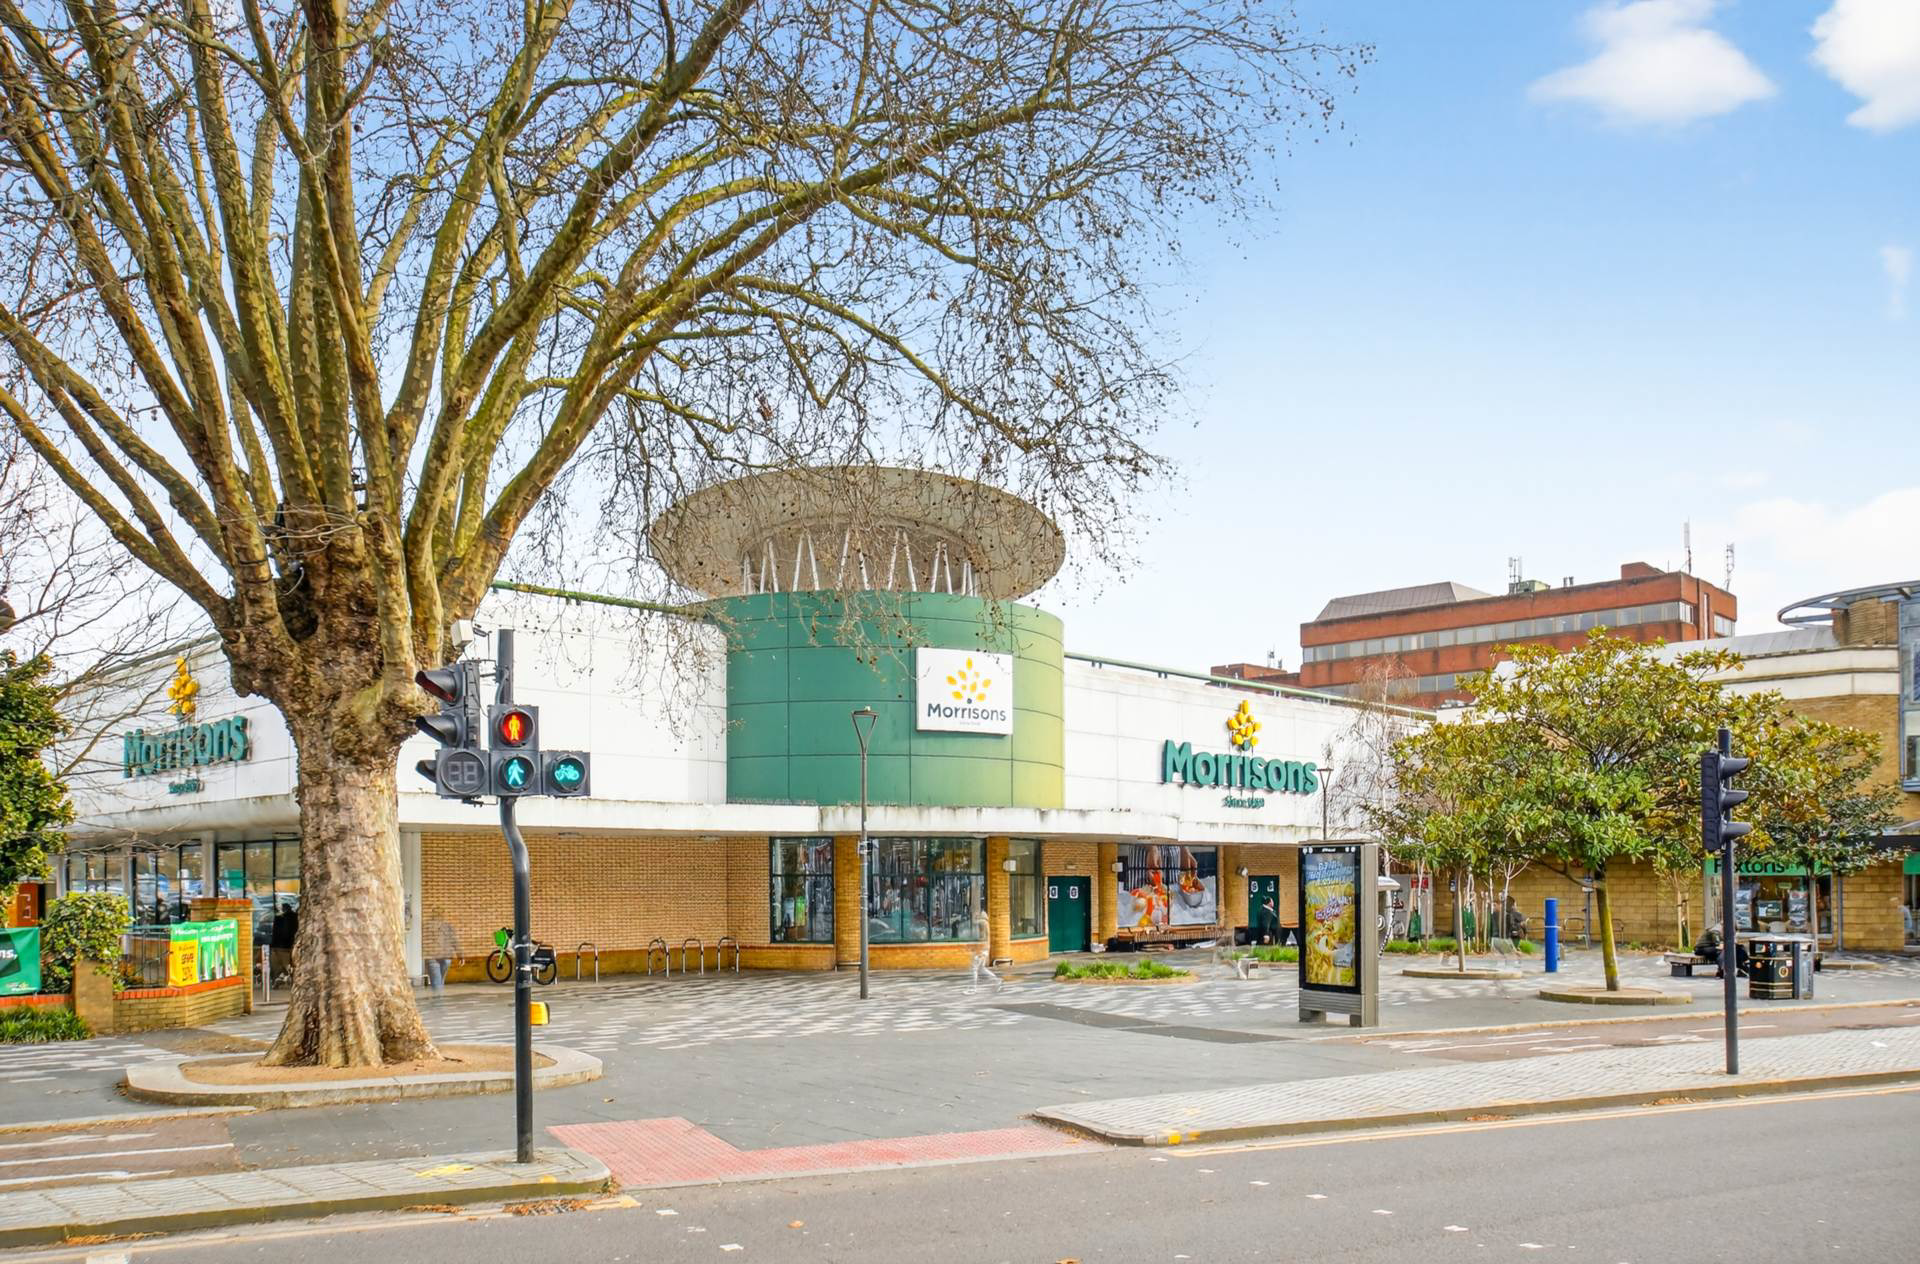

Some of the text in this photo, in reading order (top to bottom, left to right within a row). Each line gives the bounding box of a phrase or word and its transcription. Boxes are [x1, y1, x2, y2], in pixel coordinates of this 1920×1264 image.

[928, 703, 1006, 721] Morrisons
[124, 715, 249, 778] Morrisons
[1164, 740, 1318, 793] Morrisons
[1713, 858, 1785, 874] Fxtons
